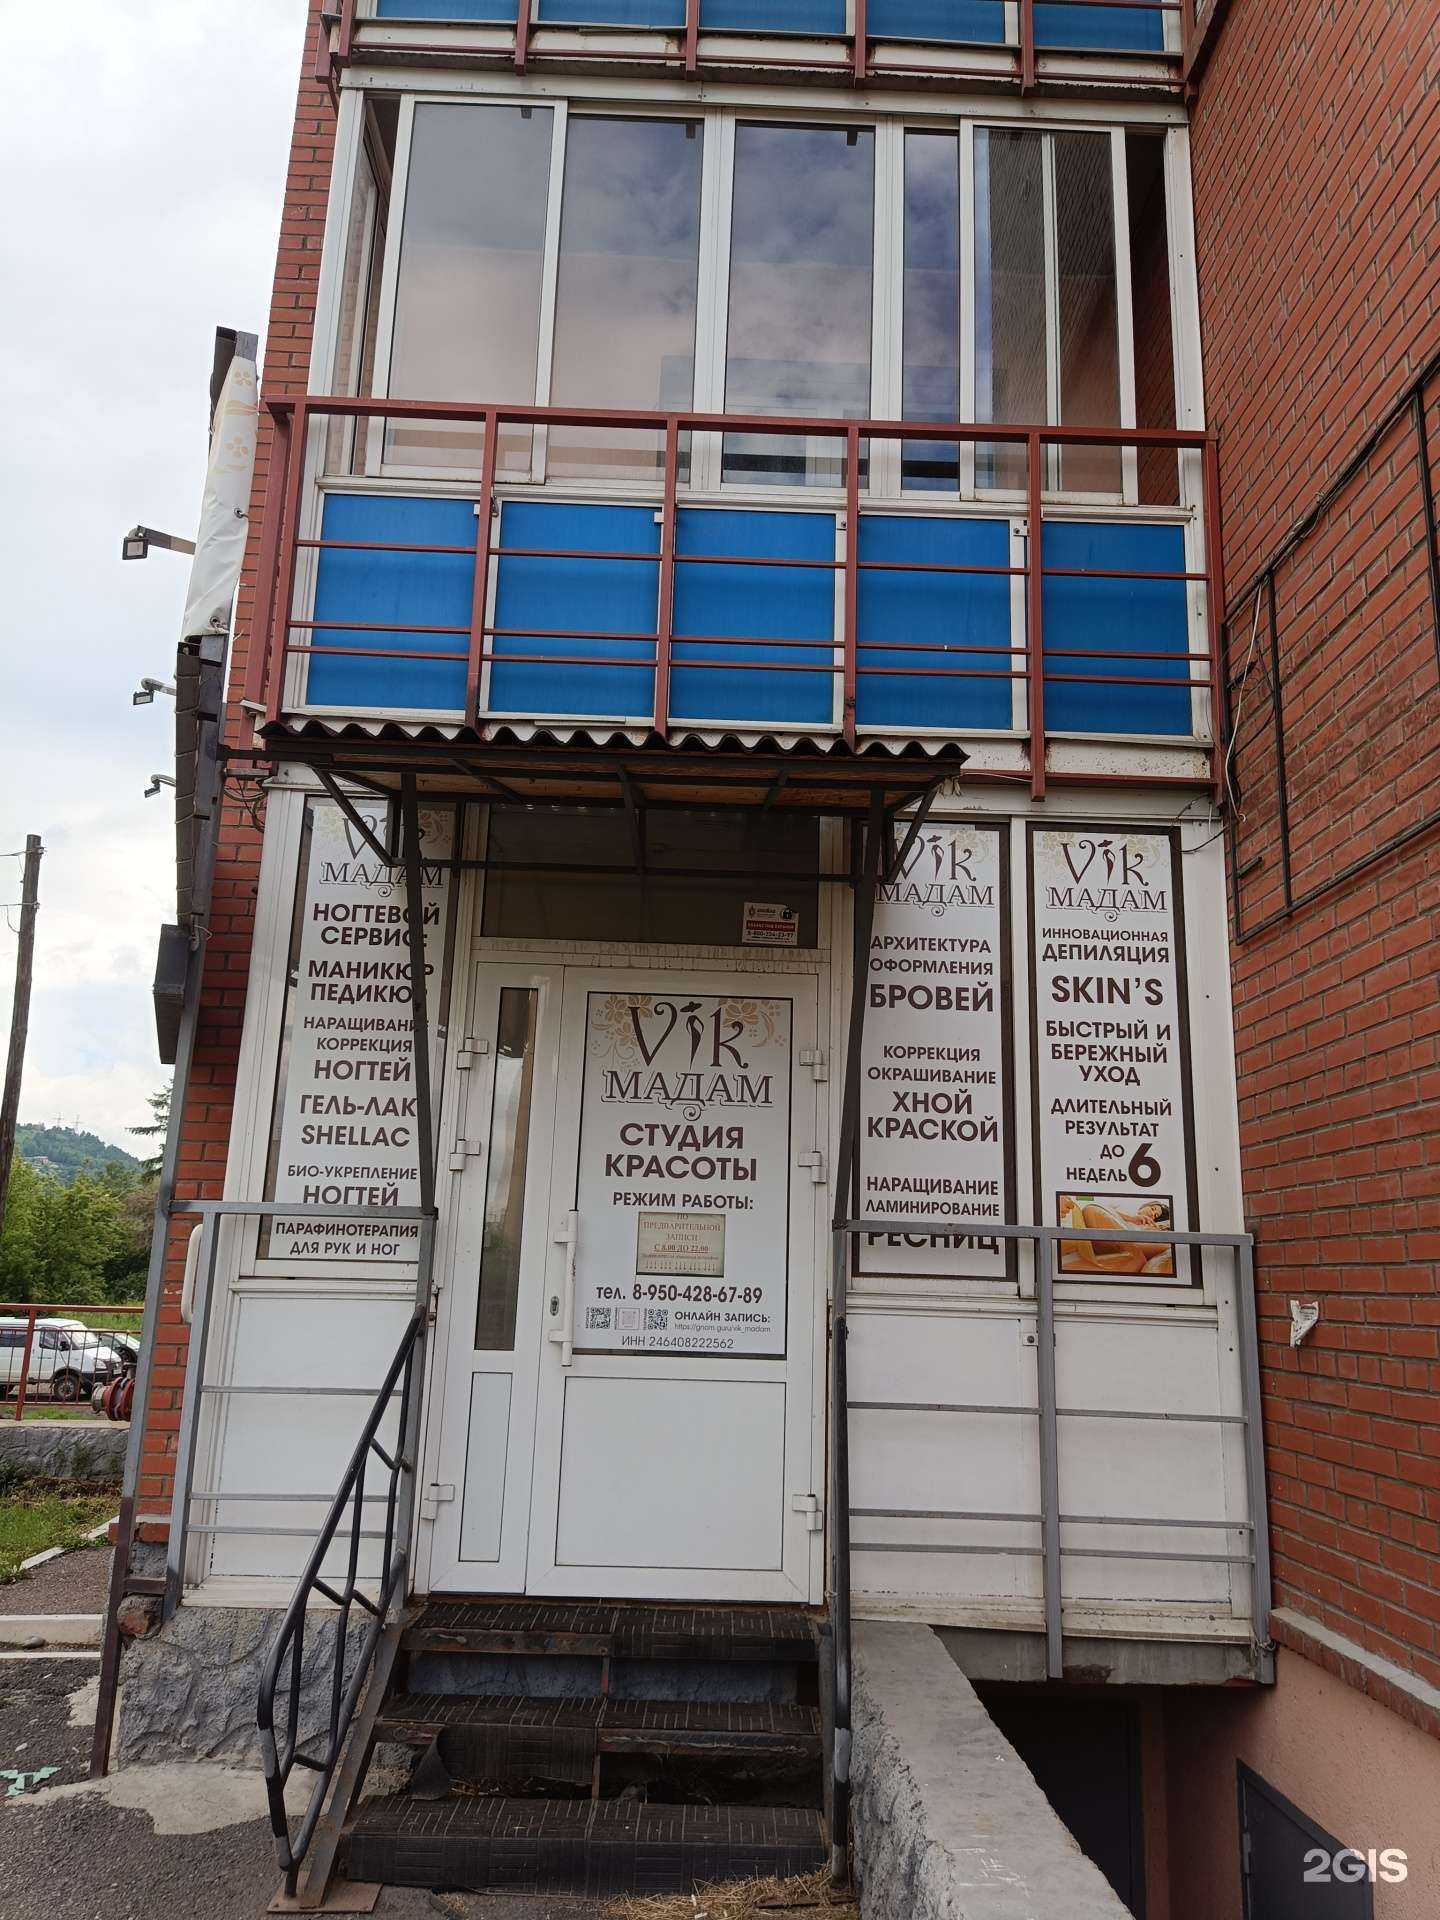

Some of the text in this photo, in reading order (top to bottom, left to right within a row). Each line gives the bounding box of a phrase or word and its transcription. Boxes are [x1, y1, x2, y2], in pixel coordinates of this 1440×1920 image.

[1060, 839, 1149, 886] Vik
[876, 882, 995, 908] МАДАМ
[1046, 886, 1168, 913] МАДАМ
[870, 936, 991, 953] АРХИТЕКТУРА
[1042, 928, 1168, 942] ИННОВАЦИОННАЯ
[1042, 943, 1169, 965] ДЕПИЛЯЦИЯ
[870, 957, 993, 975] ОФОРМЛЕНИЯ
[311, 983, 428, 1004] ПЕДИКЮ
[870, 981, 994, 1012] БРОВЕЙ
[303, 1017, 429, 1032] НАРАЩИВАН
[628, 1001, 749, 1069] Vik
[1046, 1019, 1171, 1040] БЫСТРЫЙ И
[316, 1037, 413, 1054] КОРРЕКЦИЯ
[883, 1045, 980, 1063] КОРРЕКЦИЯ
[1051, 1043, 1167, 1064] БЕРЕЖНЫЙ
[314, 1057, 411, 1081] НОГТЕЙ
[867, 1067, 996, 1084] ОКРАШИВАНИЕ
[1079, 1065, 1140, 1086] УХОД
[602, 1070, 774, 1108] МАДАМ
[300, 1094, 417, 1117] ГЕЛЬ-ЛАК
[892, 1088, 972, 1115] ХНОЙ
[1051, 1098, 1172, 1116] ДЛИТЕЛЬНЫЙ
[301, 1125, 410, 1147] SHELLAC
[620, 1123, 744, 1151] СТУДИЯ
[867, 1115, 998, 1142] КРАСКОЙ
[1065, 1120, 1159, 1137] РЕЗУЛЬТАТ
[287, 1165, 418, 1180] БИО-УКРЕПЛЕНИЕ
[605, 1154, 757, 1181] КРАСОТЫ
[1066, 1167, 1128, 1183] НЕДЕЛЬ
[1100, 1143, 1161, 1188] ДО 6
[303, 1182, 399, 1206] НОГТЕЙ
[866, 1176, 998, 1195] НАРАЩИВАНИЕ
[613, 1191, 753, 1210] РЕЖИМ РАБОТЫ:
[865, 1200, 999, 1217] ЛАМИНИРОВАНИЕ
[276, 1222, 419, 1238] ПАРАФИНОТЕРАПИЯ
[290, 1241, 400, 1256] ДЛЯ РУК И НОГ
[596, 1284, 763, 1303] тел. 8-950-428-67-89
[674, 1311, 770, 1323] ОНЛАЙН ЗАПИСЬ:
[622, 1336, 734, 1349] ИНН 246408222562
